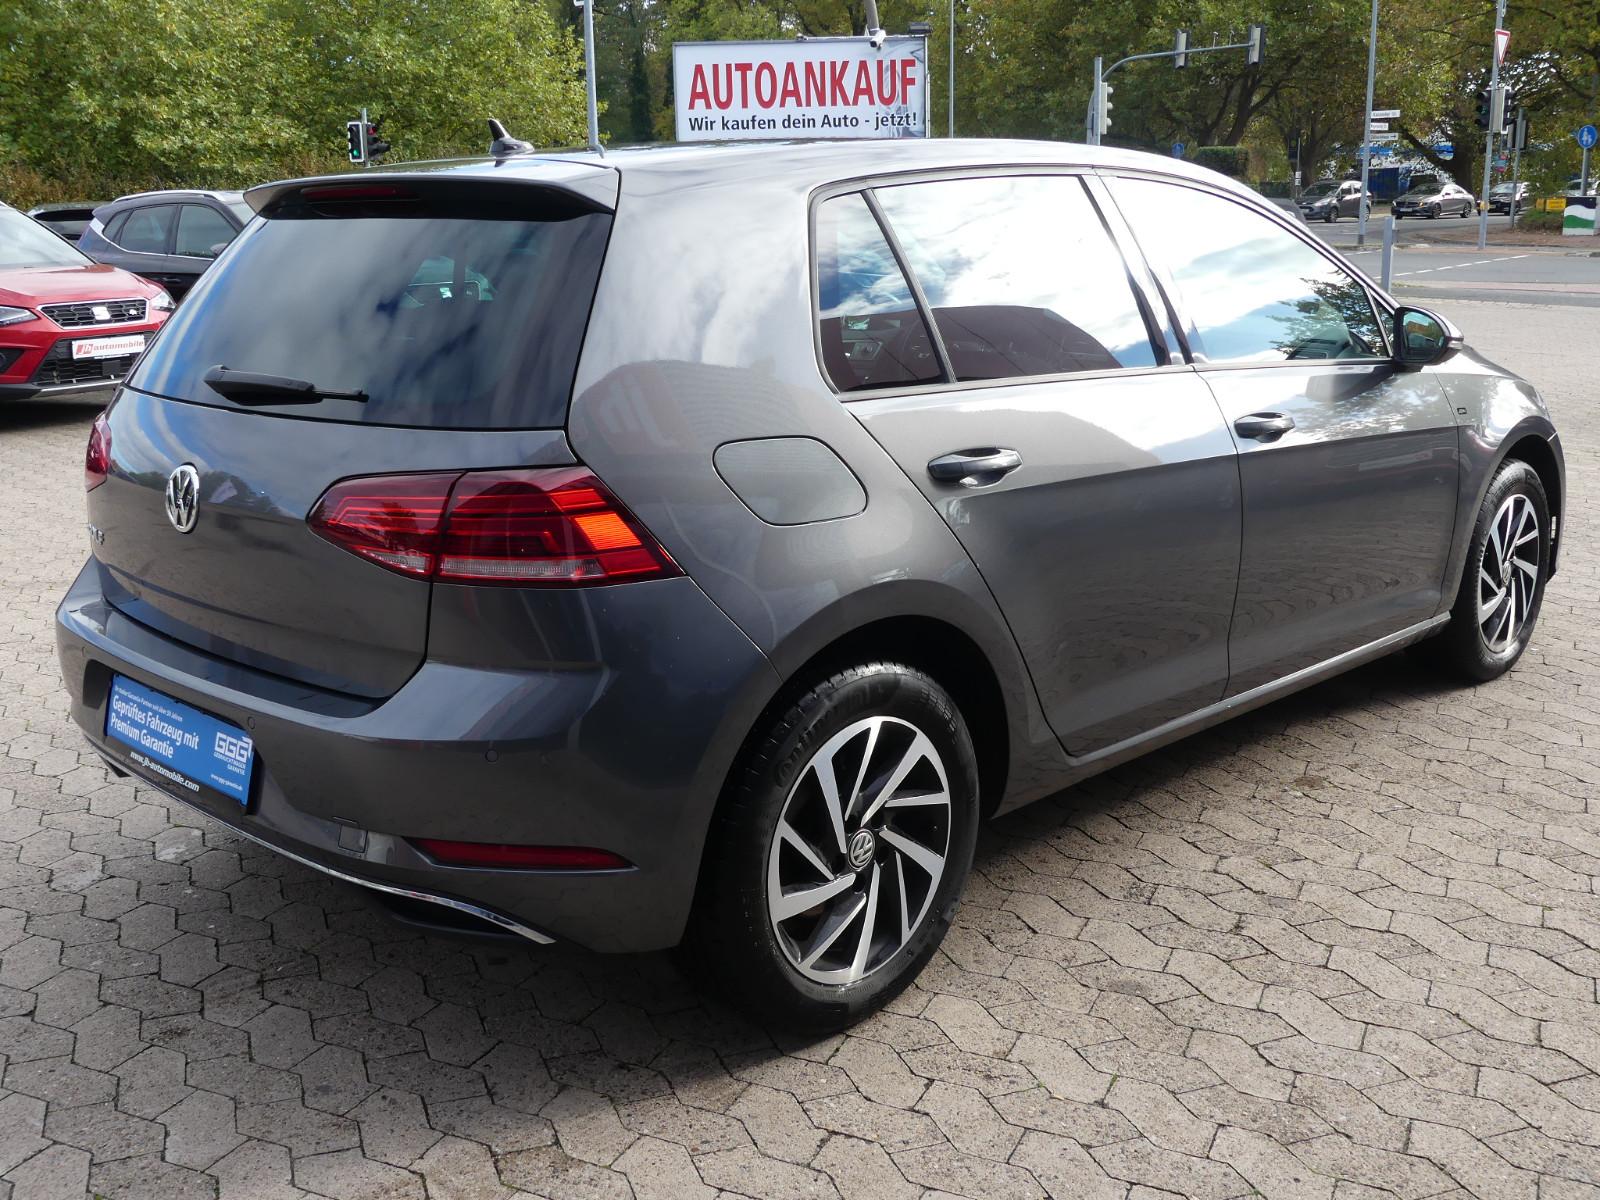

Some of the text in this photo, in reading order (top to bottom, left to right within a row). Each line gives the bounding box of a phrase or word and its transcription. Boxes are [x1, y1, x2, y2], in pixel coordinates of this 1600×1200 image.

[688, 58, 916, 111] AUTOANKAUF
[689, 116, 716, 132] Wir
[721, 114, 777, 131] kaufen
[782, 113, 816, 130] dein
[821, 113, 859, 129] Auto
[874, 111, 917, 131] jetzt!
[94, 340, 145, 351] automobile
[110, 713, 174, 759] Premium Garantie
[112, 695, 200, 750] Geprüftes Fahrzeug mit
[214, 731, 249, 763] GGG
